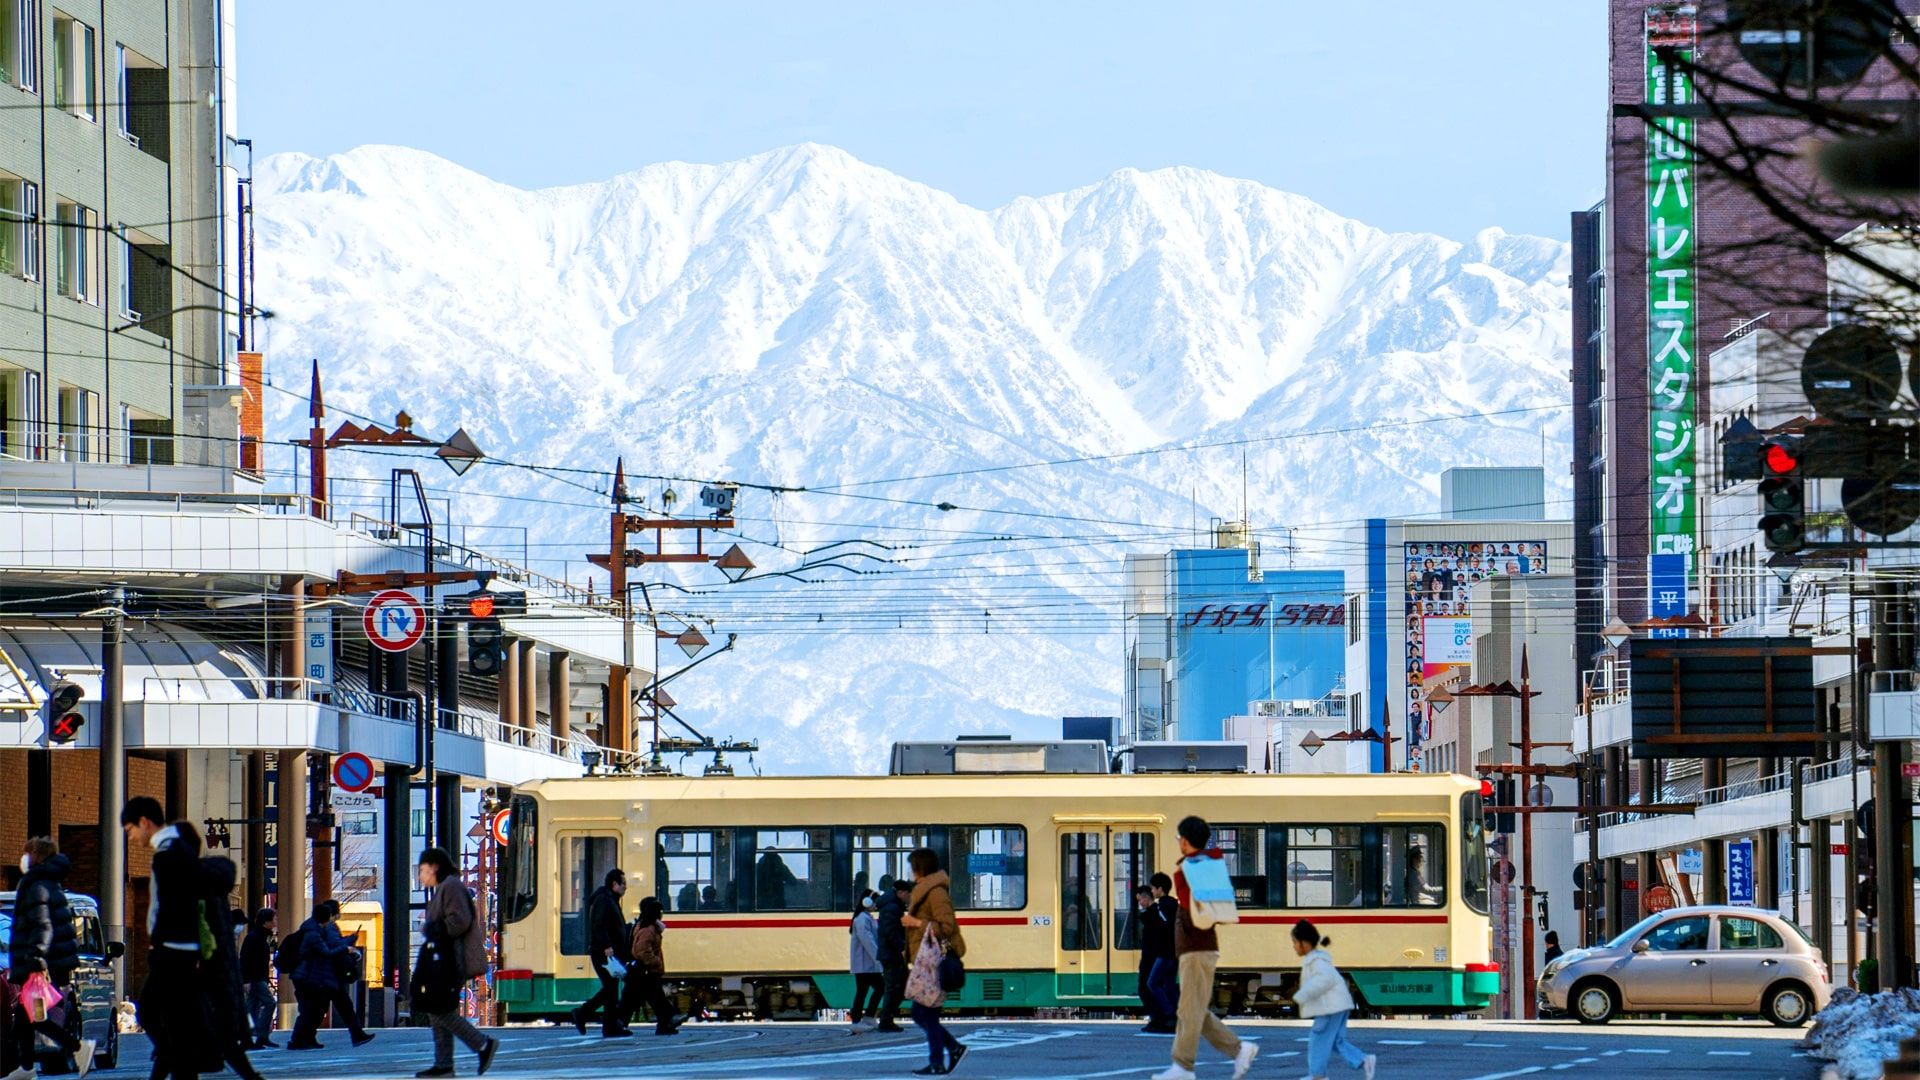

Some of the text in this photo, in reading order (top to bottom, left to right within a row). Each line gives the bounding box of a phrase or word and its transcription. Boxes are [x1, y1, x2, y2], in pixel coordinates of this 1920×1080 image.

[709, 492, 726, 505] 10
[310, 633, 325, 679] 西町
[335, 796, 372, 806] ここから
[1731, 849, 1744, 897] ユキエ
[1033, 918, 1050, 926] 入口
